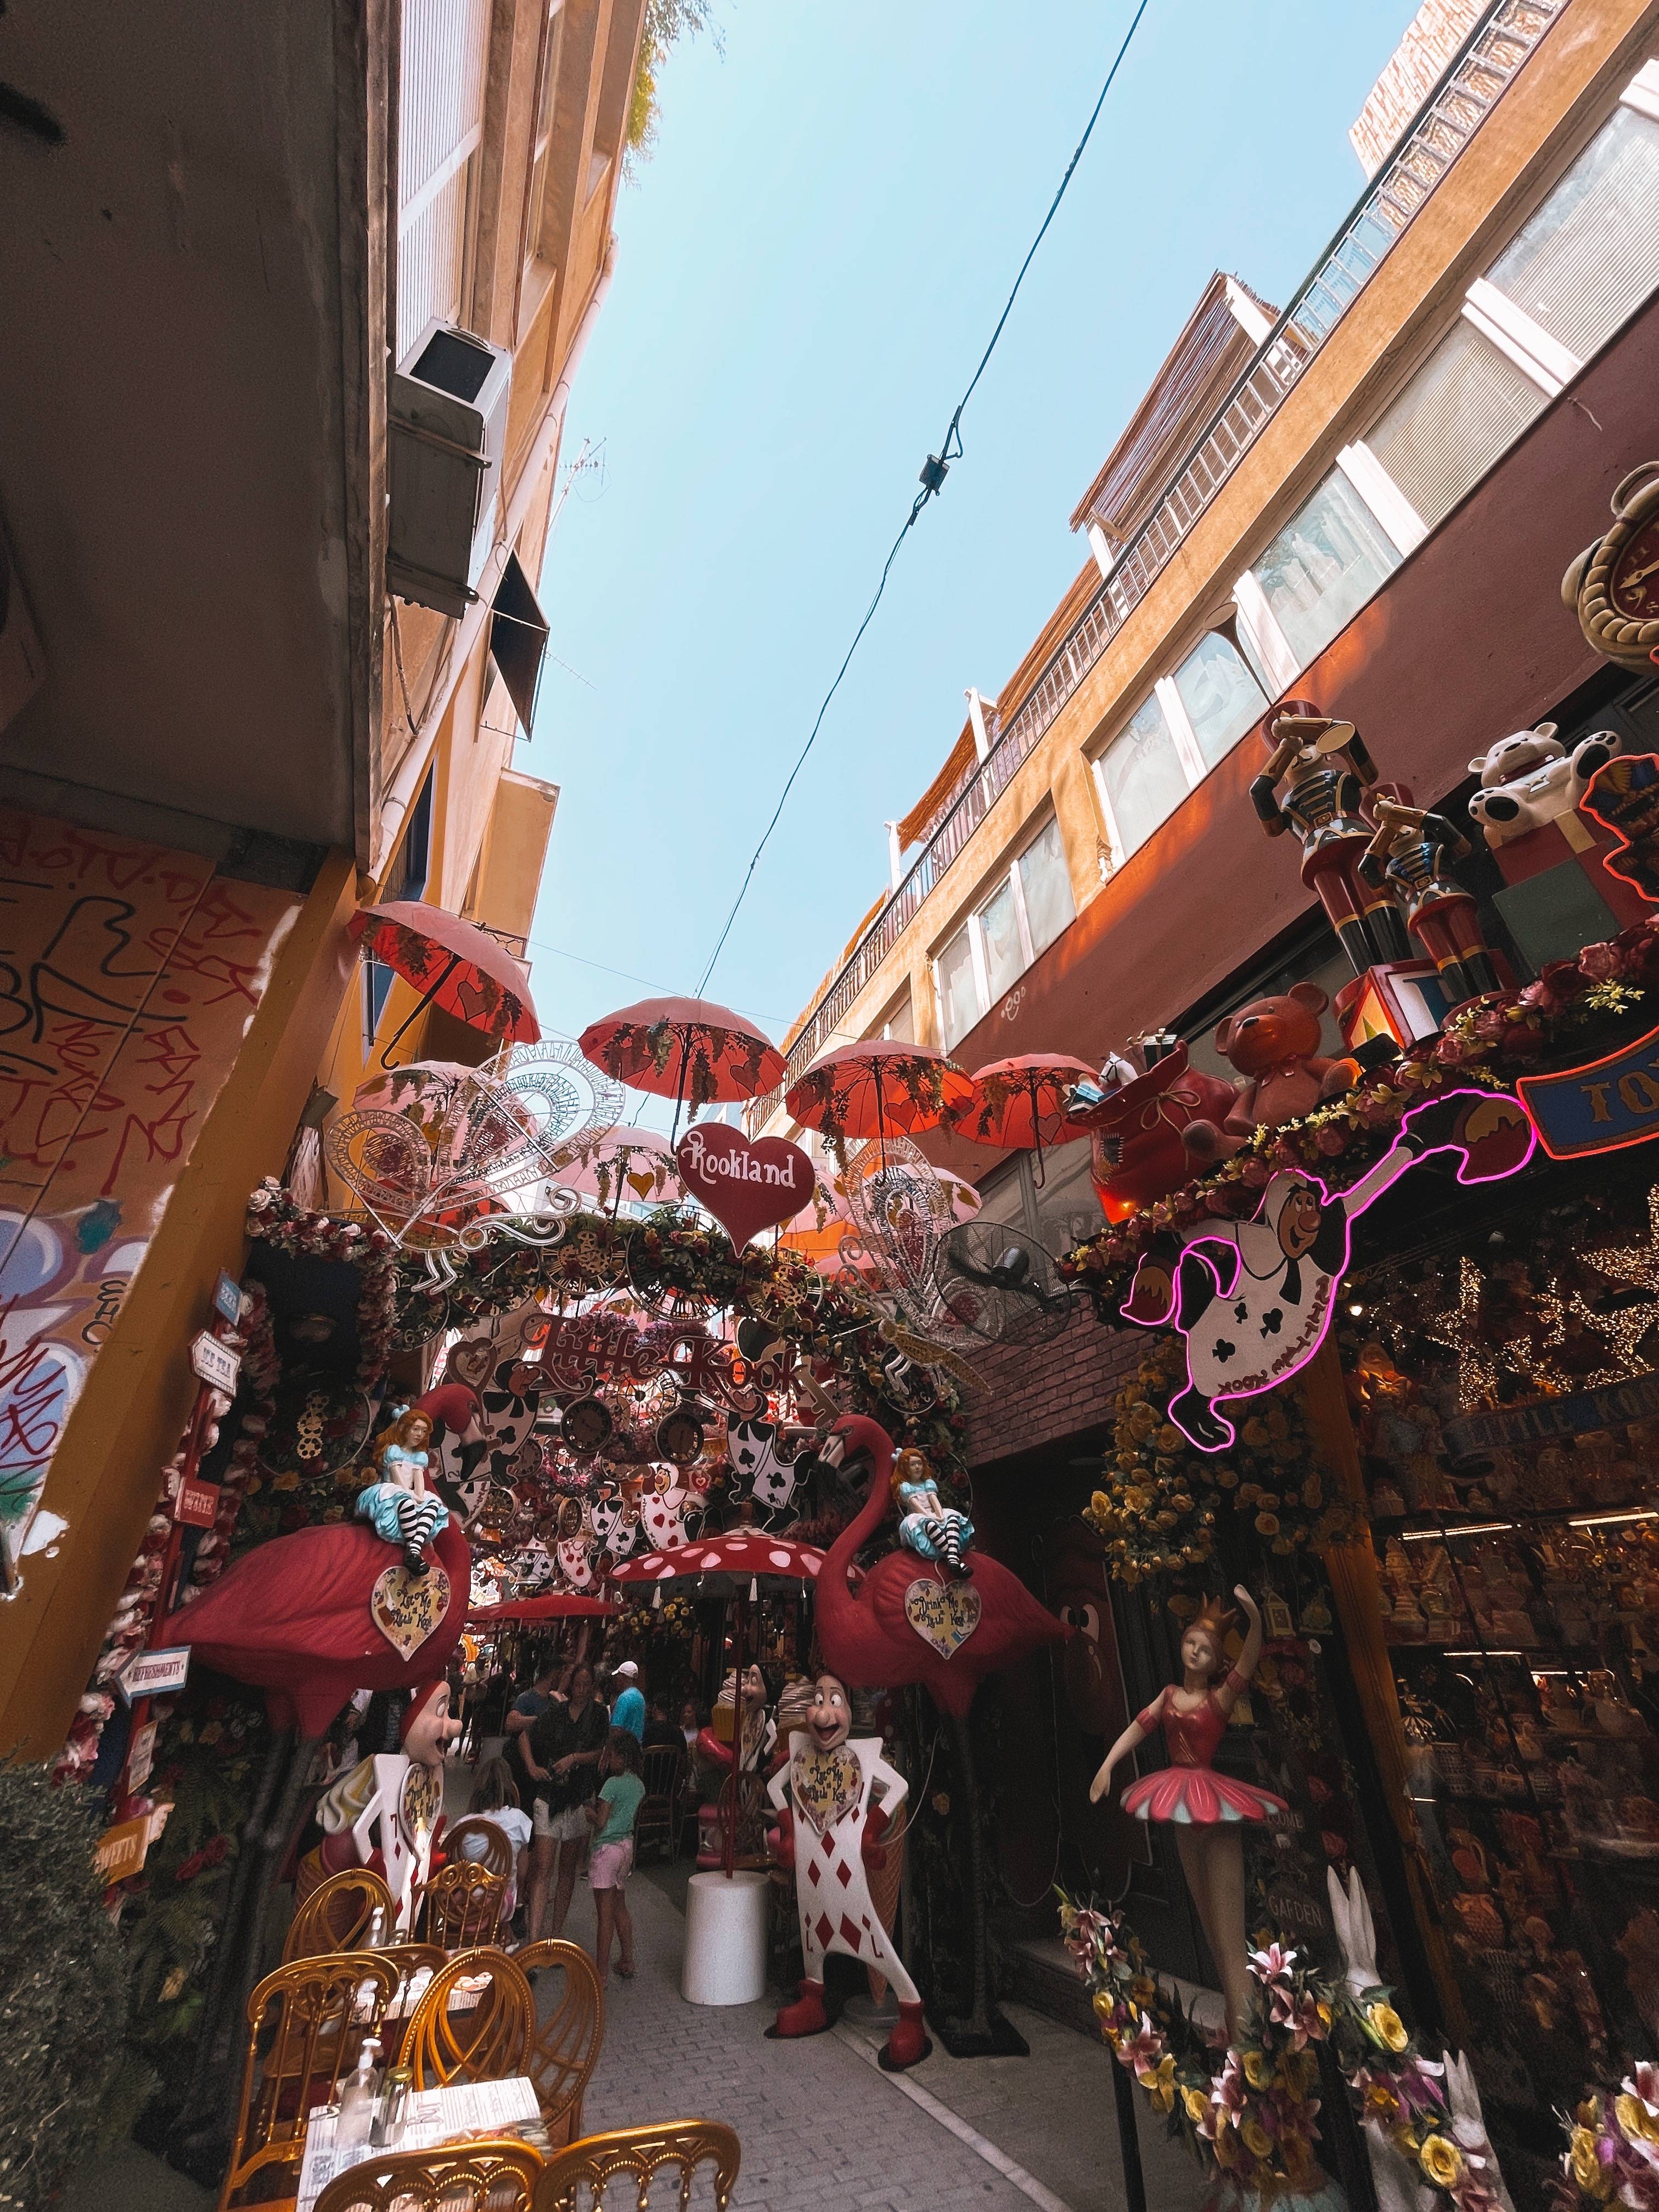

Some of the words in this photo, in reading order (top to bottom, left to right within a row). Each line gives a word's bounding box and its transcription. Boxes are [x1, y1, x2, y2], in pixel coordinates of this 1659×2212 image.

[1580, 1058, 1659, 1123] TO
[681, 1130, 796, 1189] Kookland
[1272, 1275, 1330, 1375] LITTLE
[512, 1313, 660, 1394] Little
[660, 1335, 807, 1414] Kook
[1218, 1370, 1270, 1395] KOOK
[913, 1596, 942, 1621] Drink
[132, 1661, 181, 1682] REFRESHMENTS
[390, 1814, 397, 1838] 7
[1268, 1895, 1325, 1928] GARDEN
